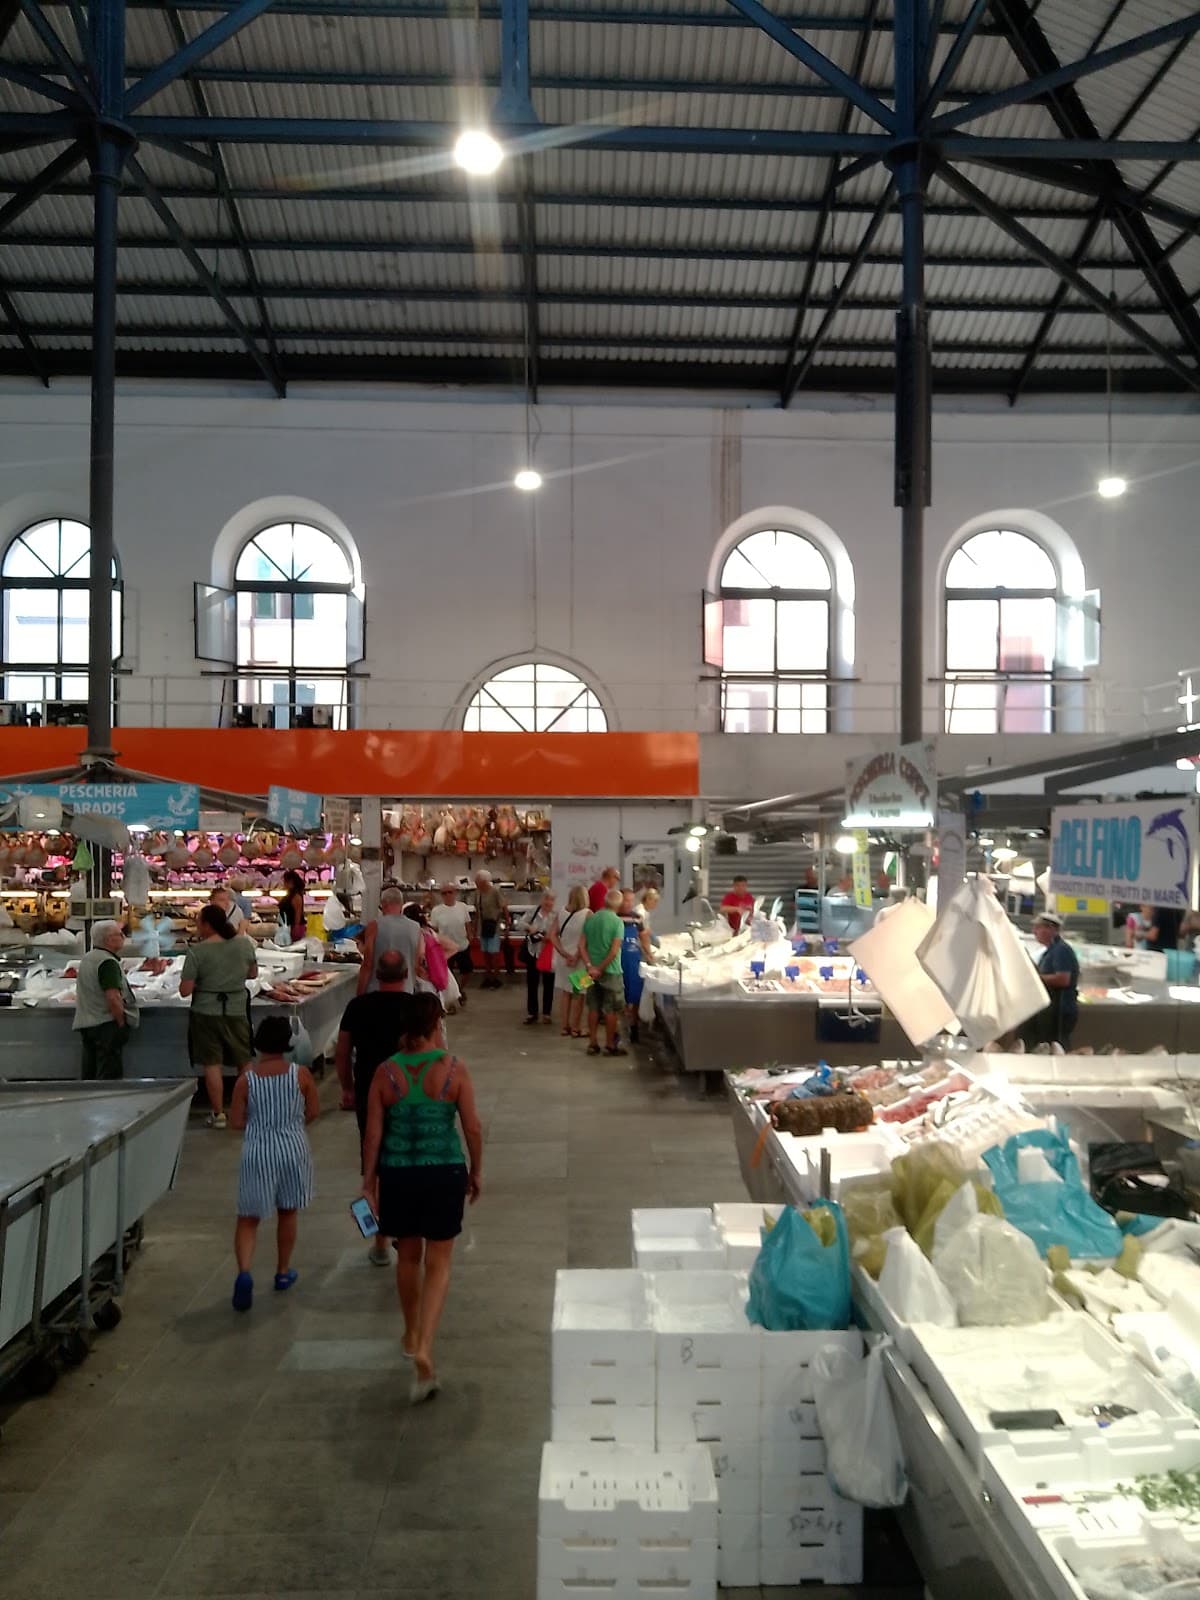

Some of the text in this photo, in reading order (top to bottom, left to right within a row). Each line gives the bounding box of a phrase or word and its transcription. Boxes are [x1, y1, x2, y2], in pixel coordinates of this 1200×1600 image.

[59, 784, 138, 798] PESCHERIA
[72, 802, 126, 814] ARADIS
[1061, 815, 1142, 882] DELFINO
[1111, 884, 1140, 899] FRUTTI
[1142, 886, 1152, 901] DI
[1154, 888, 1182, 905] MARE
